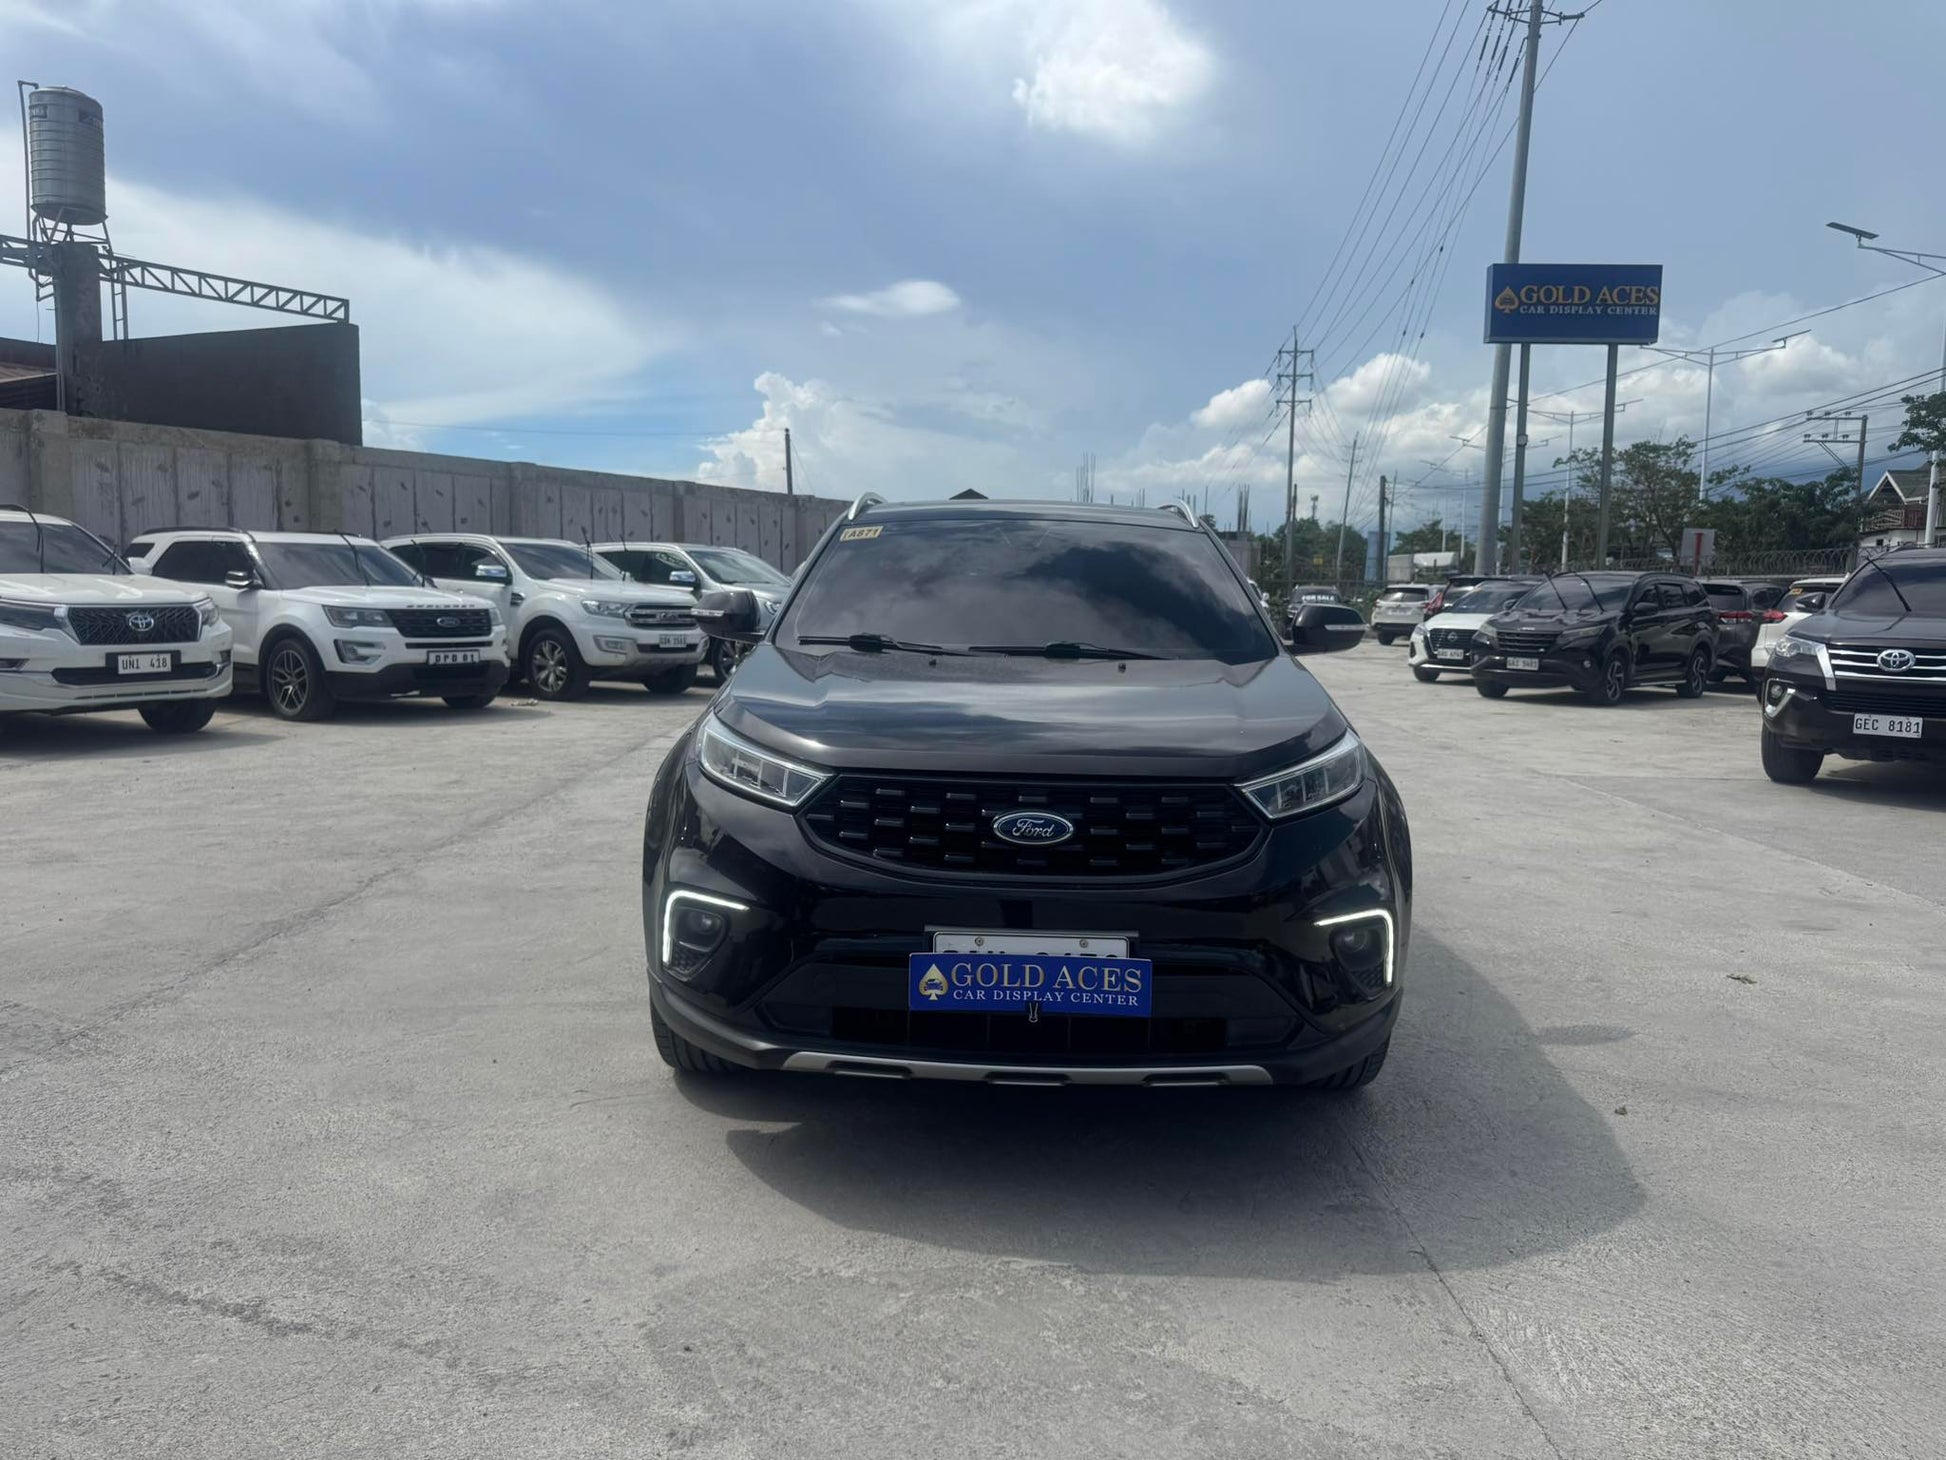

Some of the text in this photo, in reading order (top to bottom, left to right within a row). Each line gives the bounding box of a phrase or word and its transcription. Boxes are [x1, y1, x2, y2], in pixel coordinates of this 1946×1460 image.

[1519, 284, 1659, 305] GOLD ACES
[1520, 305, 1658, 316] CAR DISPLAY CENTER
[1855, 717, 1921, 734] GEC 8181
[1012, 818, 1055, 837] Ford
[951, 962, 1142, 993] GOLD ACES
[953, 989, 1139, 1006] CAR DISPLAY CENTER
